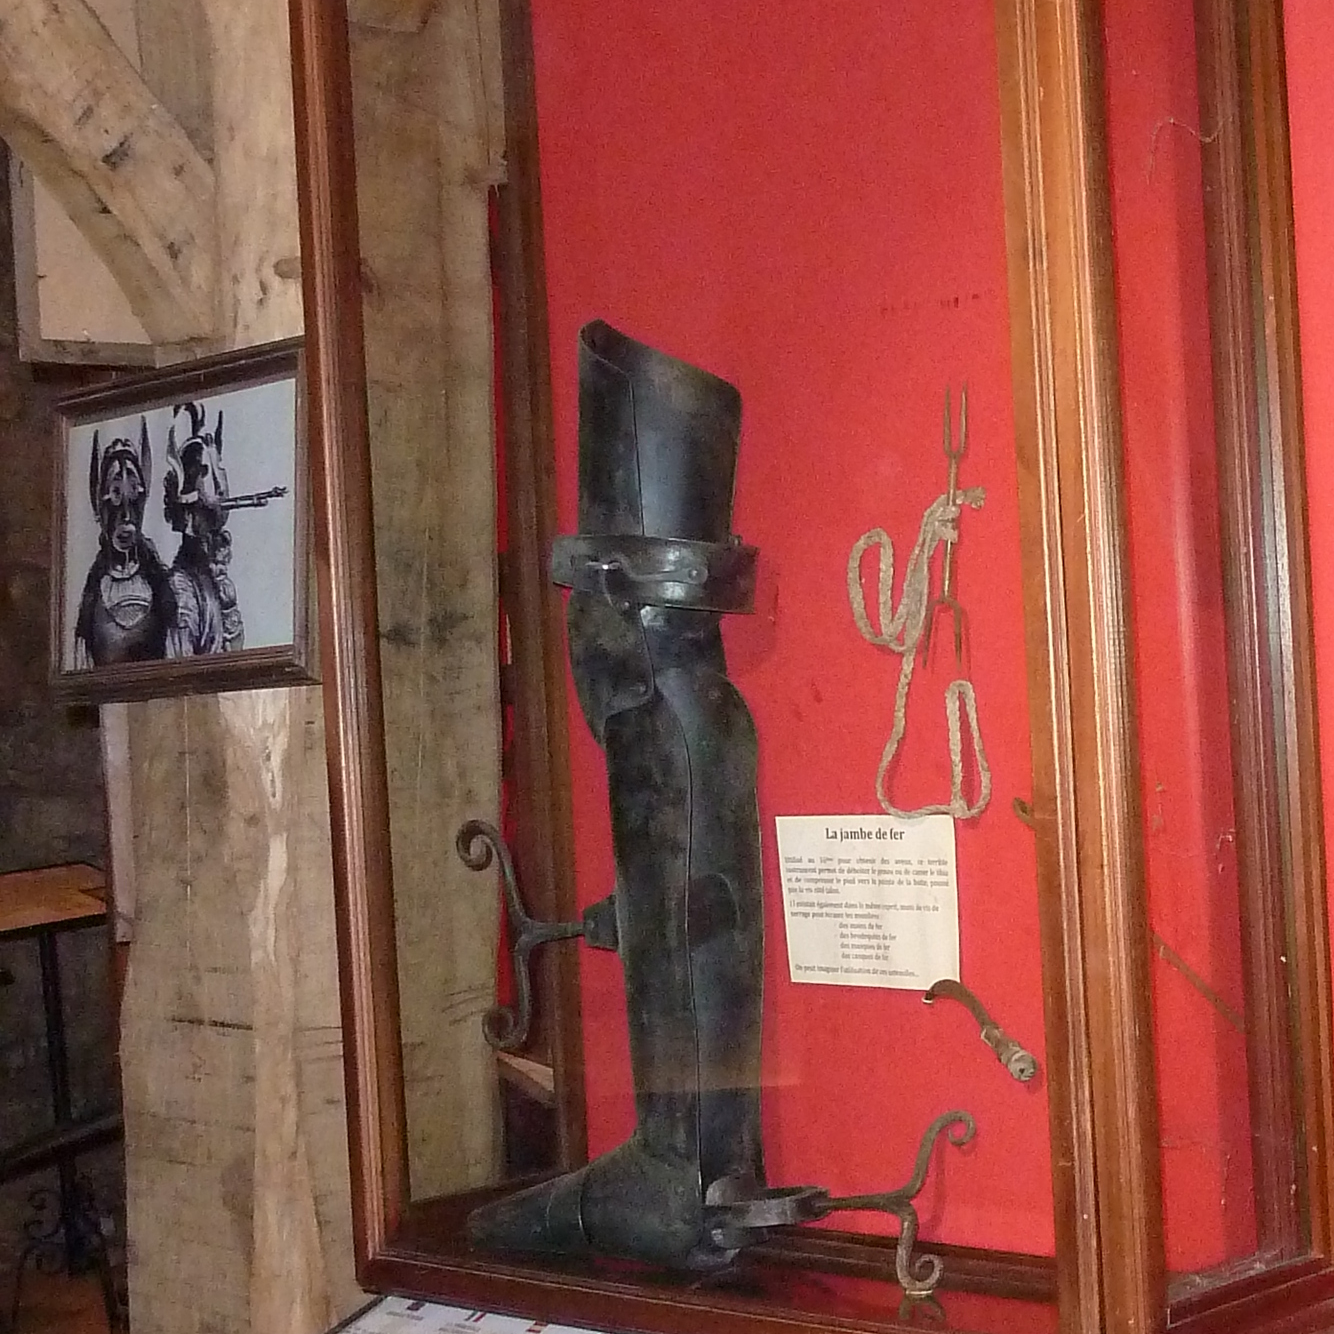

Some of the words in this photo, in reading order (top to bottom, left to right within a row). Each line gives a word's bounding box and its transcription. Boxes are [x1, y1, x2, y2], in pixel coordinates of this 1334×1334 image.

[826, 828, 837, 840] La
[840, 828, 873, 842] jambe
[875, 828, 887, 840] de
[889, 828, 905, 840] fer
